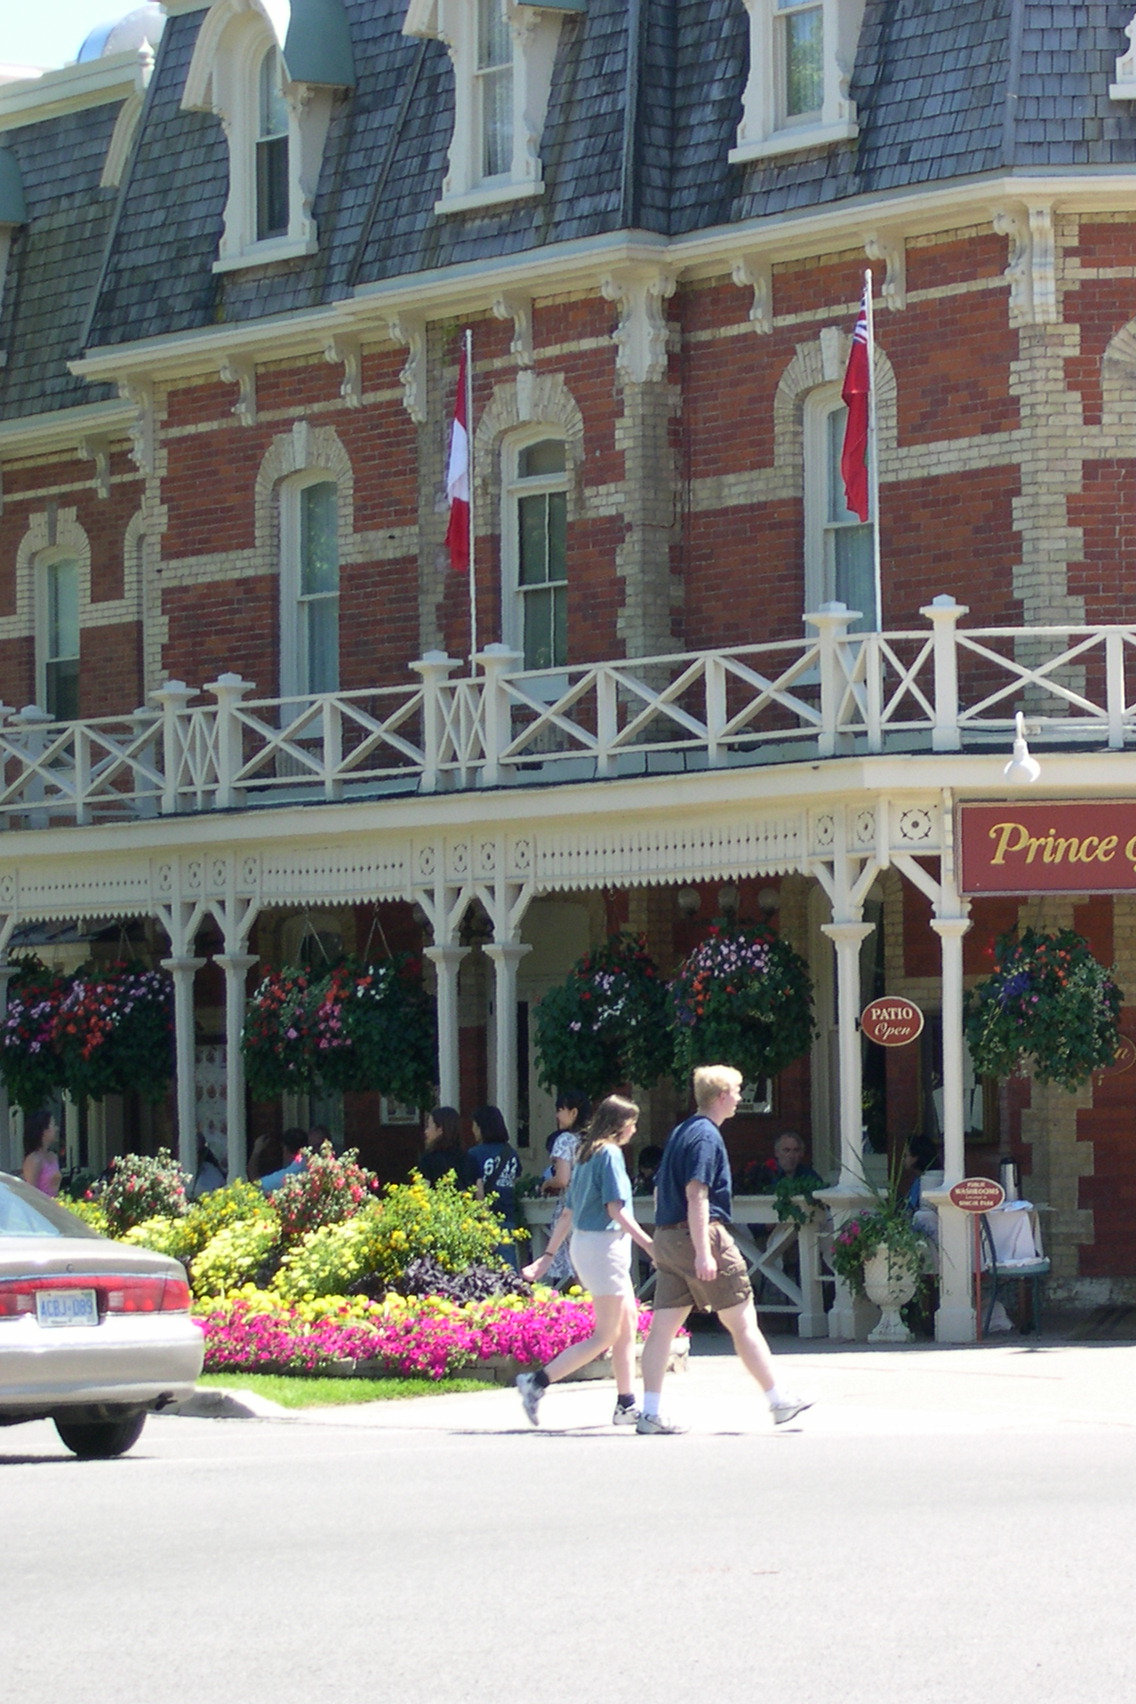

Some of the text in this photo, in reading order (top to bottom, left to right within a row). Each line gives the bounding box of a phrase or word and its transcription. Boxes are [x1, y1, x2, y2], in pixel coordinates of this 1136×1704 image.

[989, 822, 1119, 865] Prince
[871, 1006, 913, 1020] PATIO
[874, 1022, 911, 1040] Open
